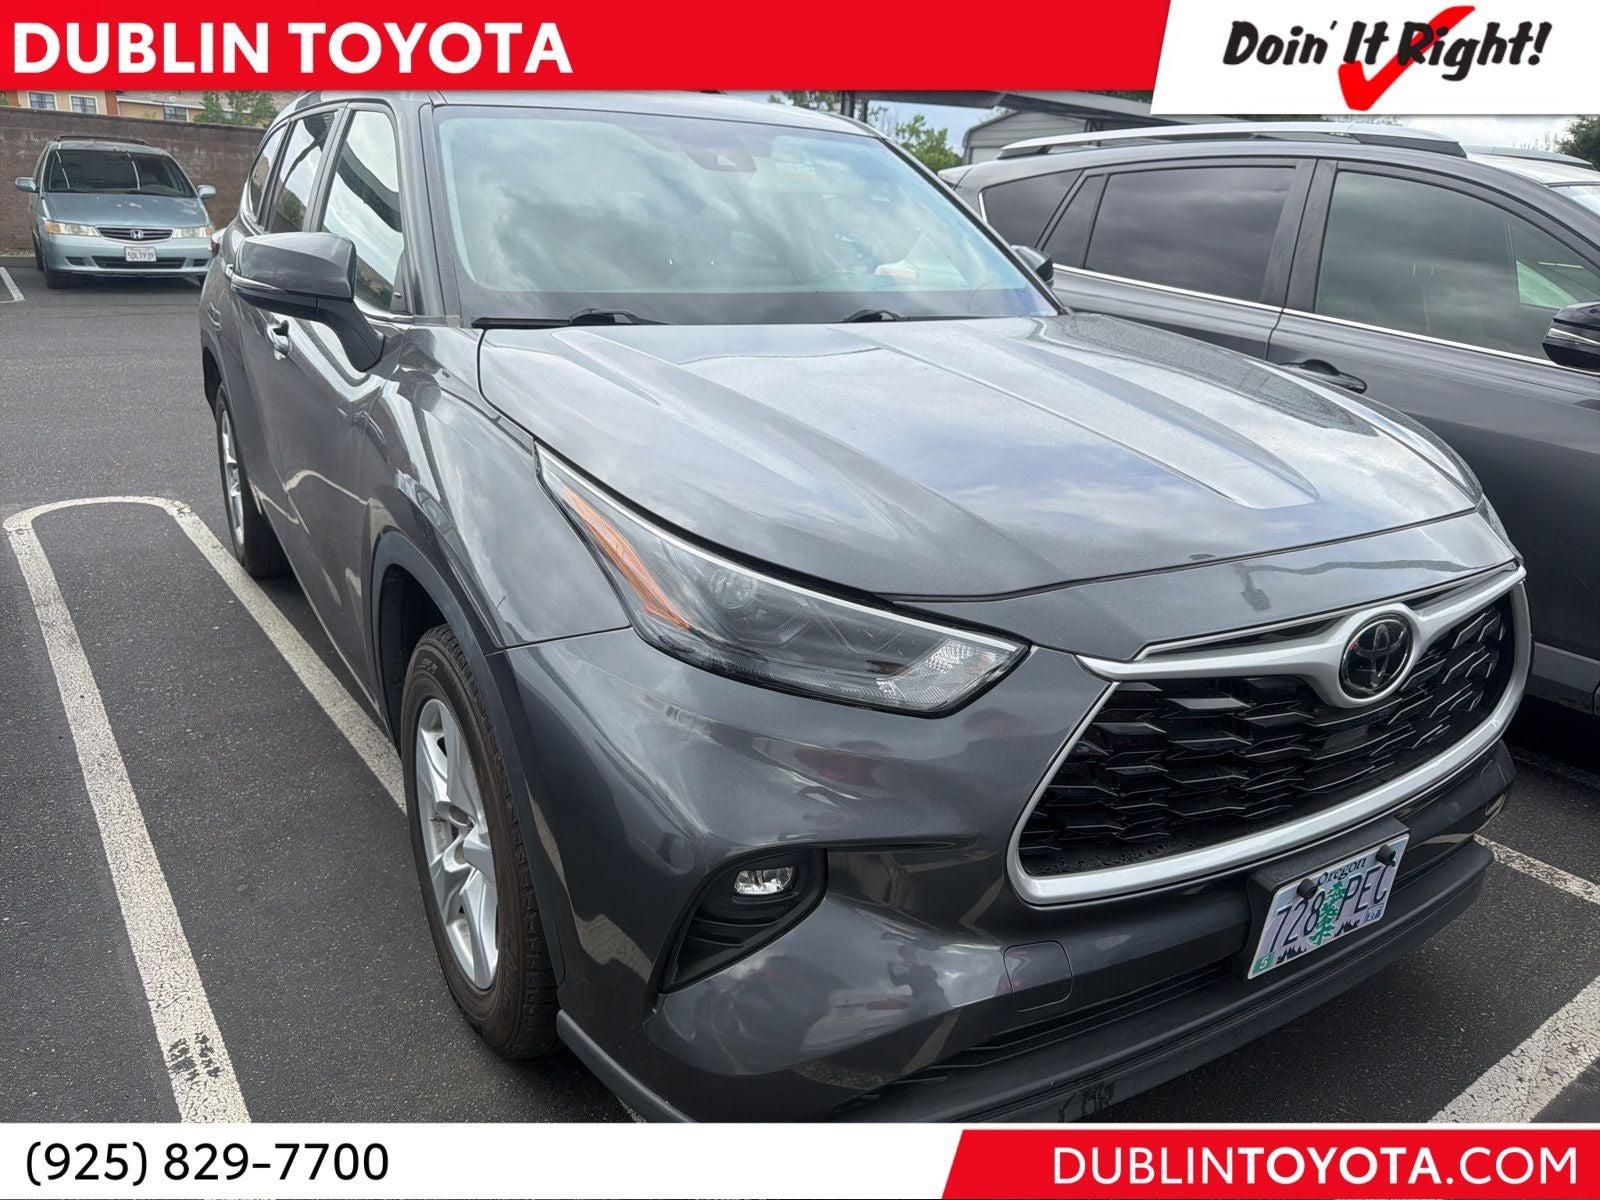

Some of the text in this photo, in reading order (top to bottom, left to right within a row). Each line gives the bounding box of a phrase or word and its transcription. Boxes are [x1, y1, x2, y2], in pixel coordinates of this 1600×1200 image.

[1317, 856, 1367, 886] Oregon
[1269, 859, 1396, 953] 728 PEC
[1258, 957, 1269, 970] 5
